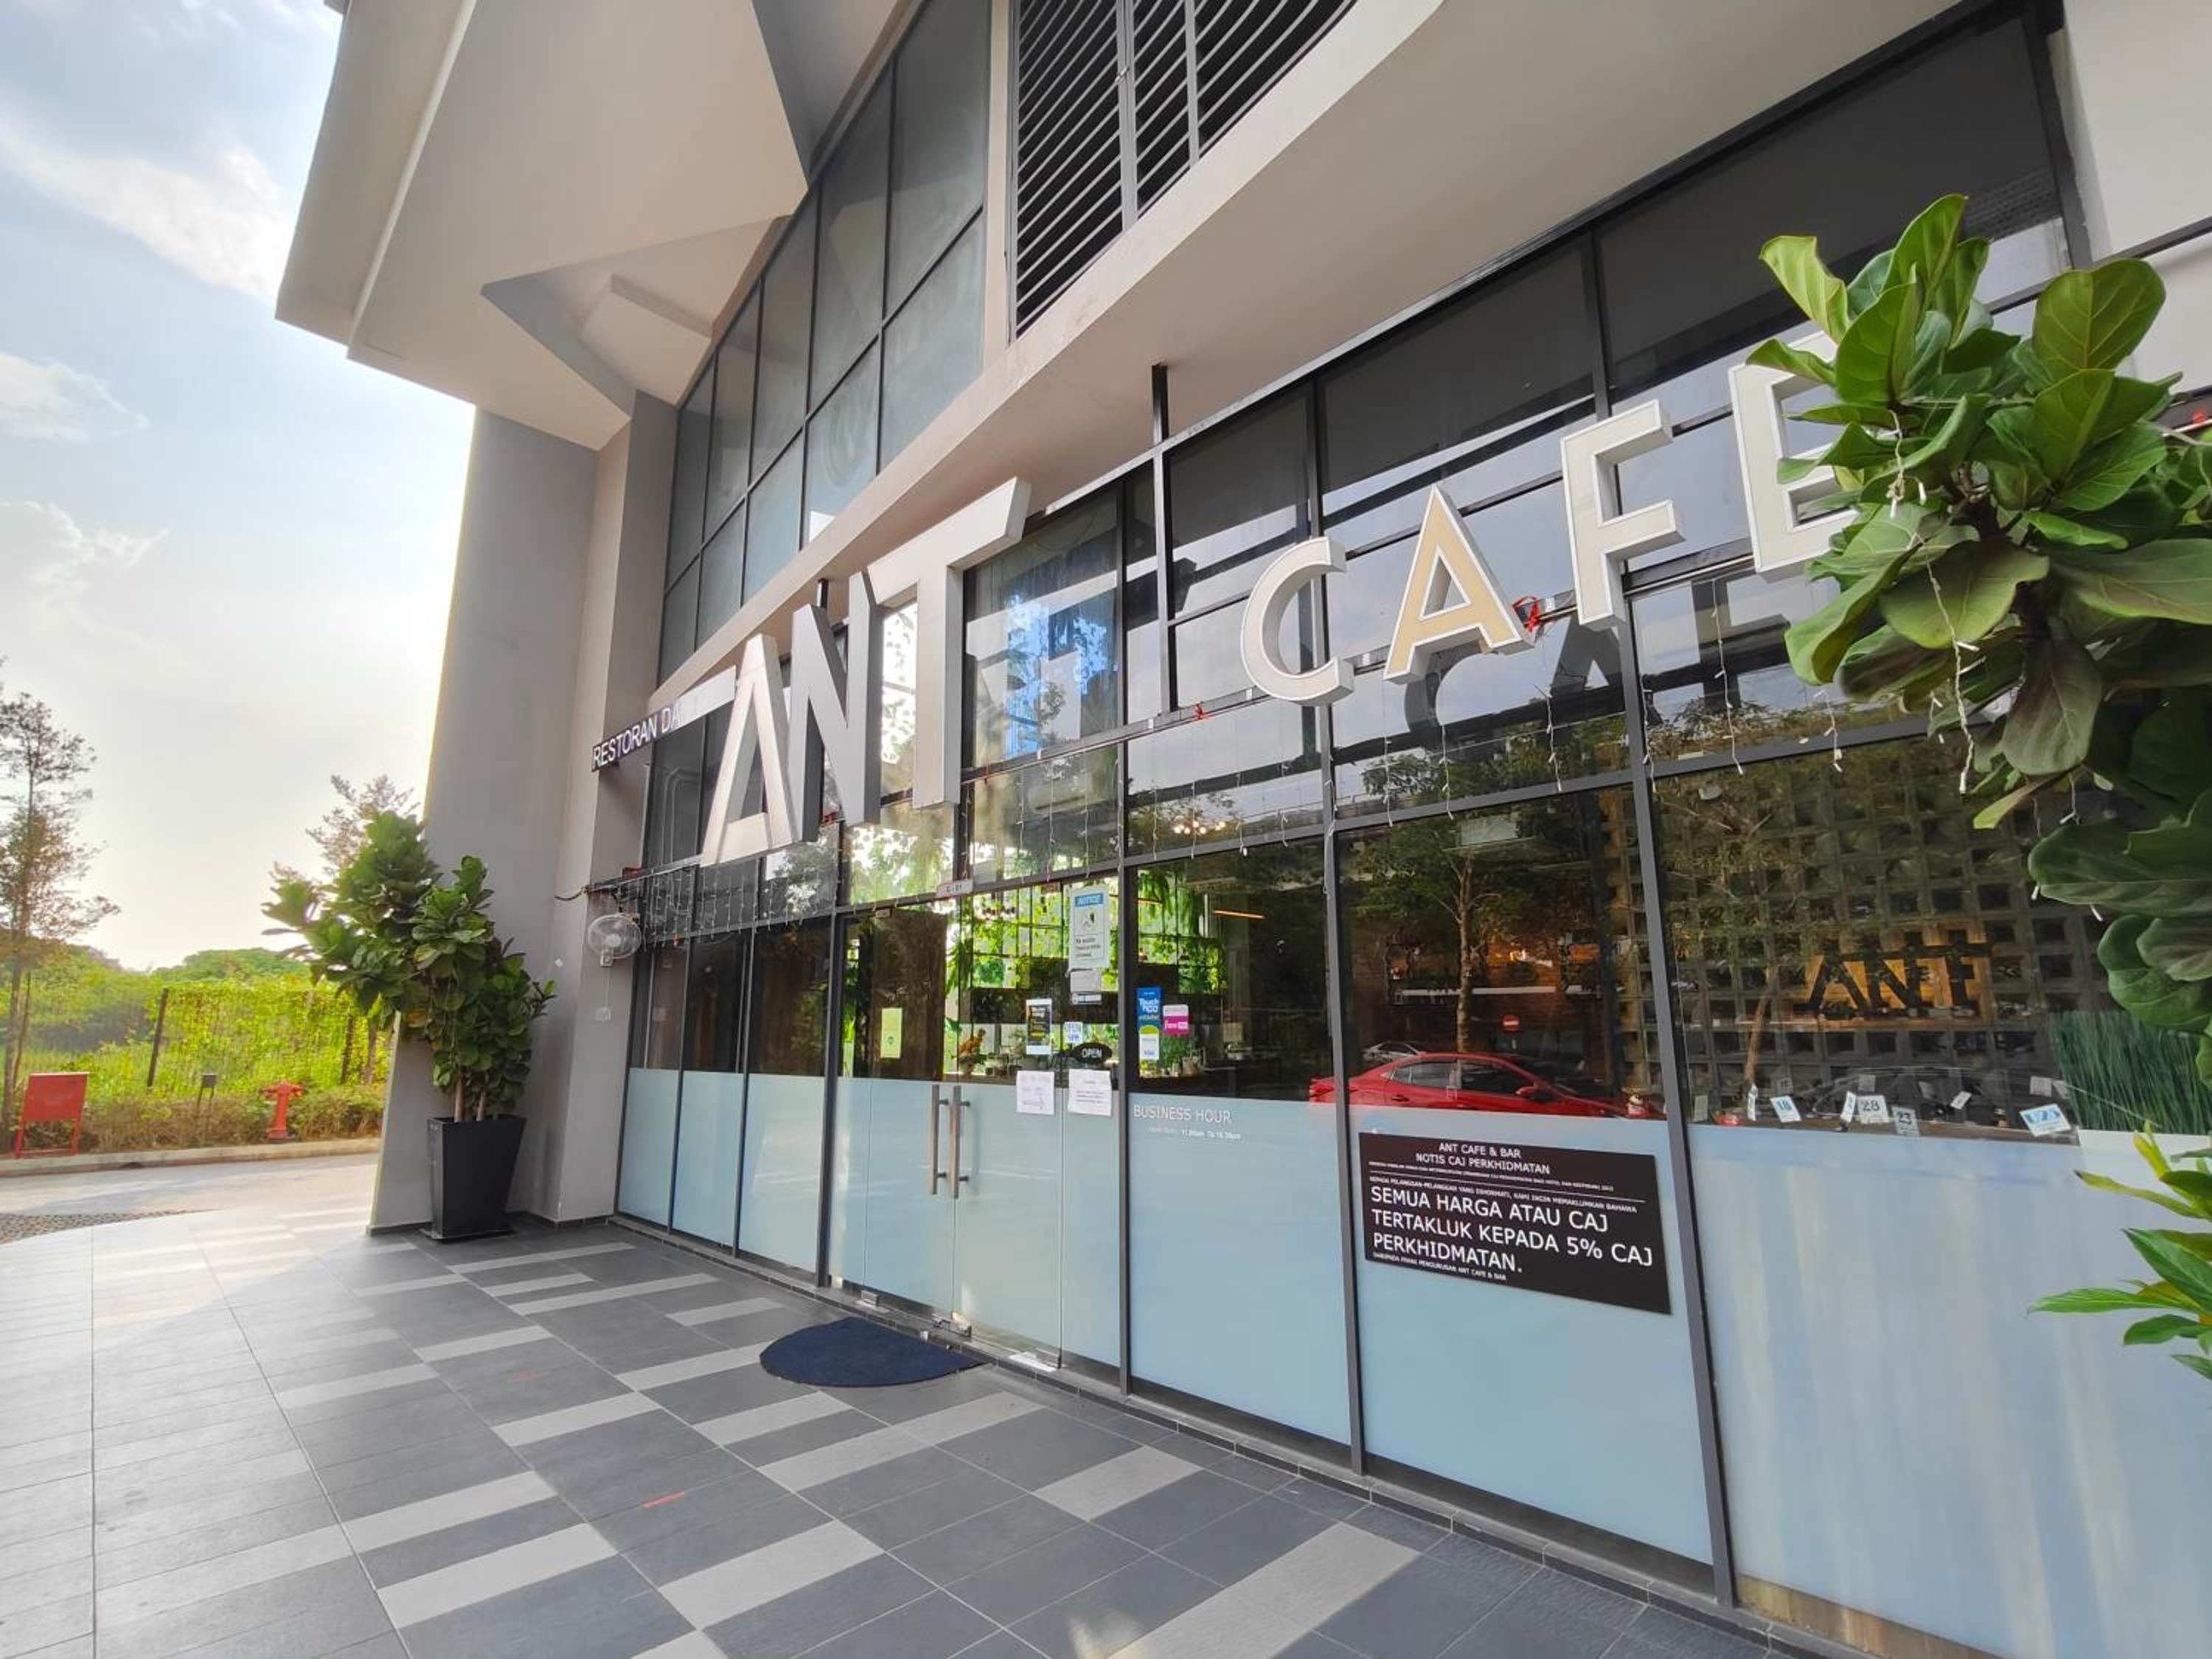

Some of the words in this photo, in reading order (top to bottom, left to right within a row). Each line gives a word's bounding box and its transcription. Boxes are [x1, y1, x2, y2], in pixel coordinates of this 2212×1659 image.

[700, 476, 1030, 868] ANT
[1240, 330, 1862, 706] CAFE
[593, 714, 658, 768] RESTORAN
[1082, 1047, 1102, 1059] OPEN
[1133, 1105, 1192, 1121] BUSINESS
[1195, 1108, 1232, 1123] HOUR
[1416, 1153, 1445, 1164] NOTIS
[1448, 1155, 1466, 1166] CAJ
[1469, 1158, 1550, 1175] PERKHIDMATAN
[1439, 1143, 1458, 1152] ANT
[1461, 1144, 1486, 1155] CAFE
[1489, 1147, 1498, 1156] &
[1500, 1148, 1521, 1158] BAR
[1371, 1186, 1430, 1209] SEMUA
[1437, 1194, 1503, 1218] HARGA
[1509, 1203, 1560, 1226] ATAU
[1568, 1211, 1607, 1232] CAJ
[1371, 1208, 1473, 1239] TERTAKLUK
[1479, 1224, 1559, 1253] KEPADA
[1567, 1237, 1603, 1259] 5%
[1611, 1243, 1652, 1266] CAJ
[1374, 1233, 1523, 1273] PERKHIDMATAN.
